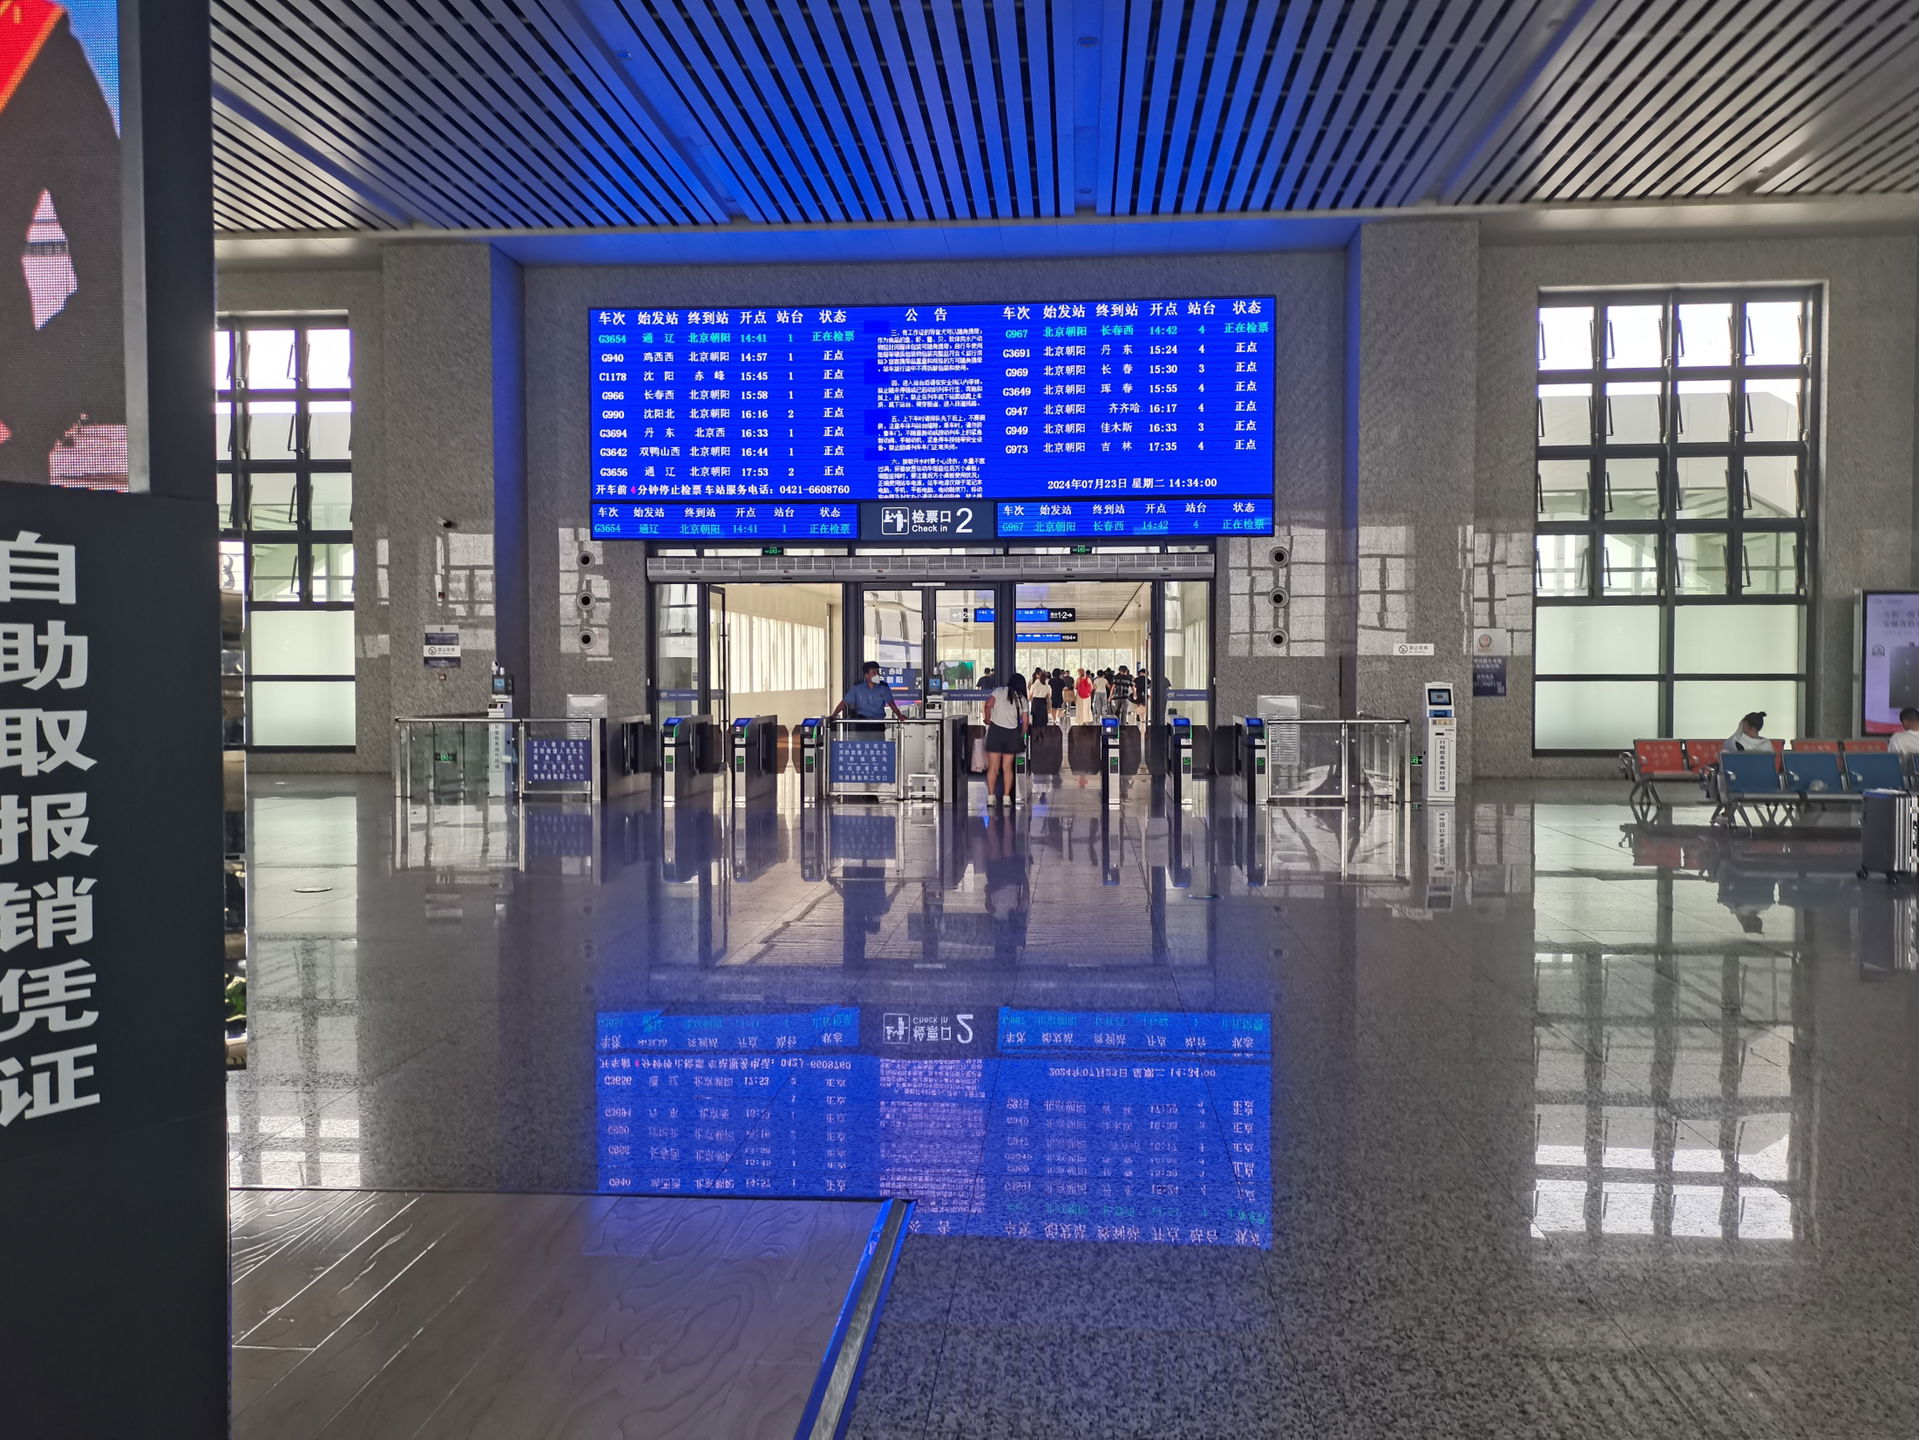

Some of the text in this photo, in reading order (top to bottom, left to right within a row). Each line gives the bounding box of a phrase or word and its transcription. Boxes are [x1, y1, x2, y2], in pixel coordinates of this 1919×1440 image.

[1003, 301, 1261, 320] 车次 始发站 终到站 开点 站台 状态
[600, 310, 846, 325] 车次 始发站 终到站 开点 站台 状态
[1006, 330, 1028, 338] G967
[1043, 326, 1086, 337] 北京朝阳
[1101, 325, 1133, 335] 长春西
[1151, 326, 1177, 335] 14:42
[1225, 322, 1269, 333] 正在检票
[599, 335, 626, 343] G3654
[688, 333, 730, 343] 北京朝阳
[741, 334, 766, 342] 14:41
[788, 334, 794, 342] 1
[813, 331, 854, 341] 正在检票
[1003, 349, 1030, 357] G3691
[1043, 346, 1085, 356] 北京朝阳
[1150, 345, 1177, 354] 15:24
[1198, 345, 1205, 353] 4
[1235, 342, 1257, 352] 正点
[602, 350, 844, 362] G940 鸡西西 北京朝阳 14:57 1 正点
[599, 373, 626, 381] C1178
[741, 372, 768, 380] 15:45
[788, 372, 794, 380] 1
[824, 369, 844, 379] 正点
[1006, 368, 1028, 377] G969
[1044, 365, 1085, 376] 北京朝阳
[1150, 365, 1177, 373] 15:30
[1198, 364, 1205, 372] 3
[1236, 362, 1257, 372] 正点
[602, 388, 844, 400] G966 长春西 北京朝阳 15:58 1 正点
[1003, 388, 1031, 396] G3649
[1044, 385, 1085, 395] 北京朝阳
[1150, 384, 1177, 393] 15:55
[1198, 384, 1205, 392] 4
[1235, 381, 1256, 391] 正点
[602, 407, 844, 419] G990 沈阳北 北京朝阳 16:16 2 正点
[1006, 407, 1028, 415] G947
[1044, 404, 1085, 415] 北京朝阳
[1150, 404, 1177, 413] 16:17
[1197, 404, 1205, 412] 4
[1235, 401, 1256, 411] 正点
[600, 429, 627, 437] G3694
[695, 428, 725, 437] 北京西
[742, 429, 768, 437] 16:33
[789, 429, 794, 437] 1
[824, 426, 844, 436] 正点
[1006, 420, 1256, 435] G949 北京朝阳 佳木斯 16:33 3 正点
[600, 446, 844, 456] G3642 双鸭山西 北京朝阳 16:44 1 正点
[1006, 445, 1028, 453] G973
[1044, 442, 1085, 452] 北京朝阳
[1150, 442, 1177, 451] 17:35
[1197, 442, 1205, 450] 4
[1235, 439, 1256, 449] 正点
[600, 468, 628, 476] G3656
[690, 467, 730, 476] 北京朝阳
[742, 468, 768, 476] 17:53
[787, 468, 795, 476] 2
[824, 466, 844, 476] 正点
[1048, 478, 1217, 489] 2024年07月23日 星期二 14:34:00
[596, 485, 627, 495] 开车前
[638, 485, 701, 495] 分钟停止检票
[780, 485, 849, 493] 0421-6608760
[599, 507, 840, 517] 车次 始发站 终到站 开点 站台 状态
[1004, 502, 1254, 515] 车次 始发站 终到站 开点 站台 状态
[912, 508, 973, 533] 检票口 2
[1002, 518, 1266, 532] G967 北京朝阳 长春西 14:42 4 正在检票
[594, 524, 850, 534] G3654 通辽 北京朝阳 14:41 1 正在检票
